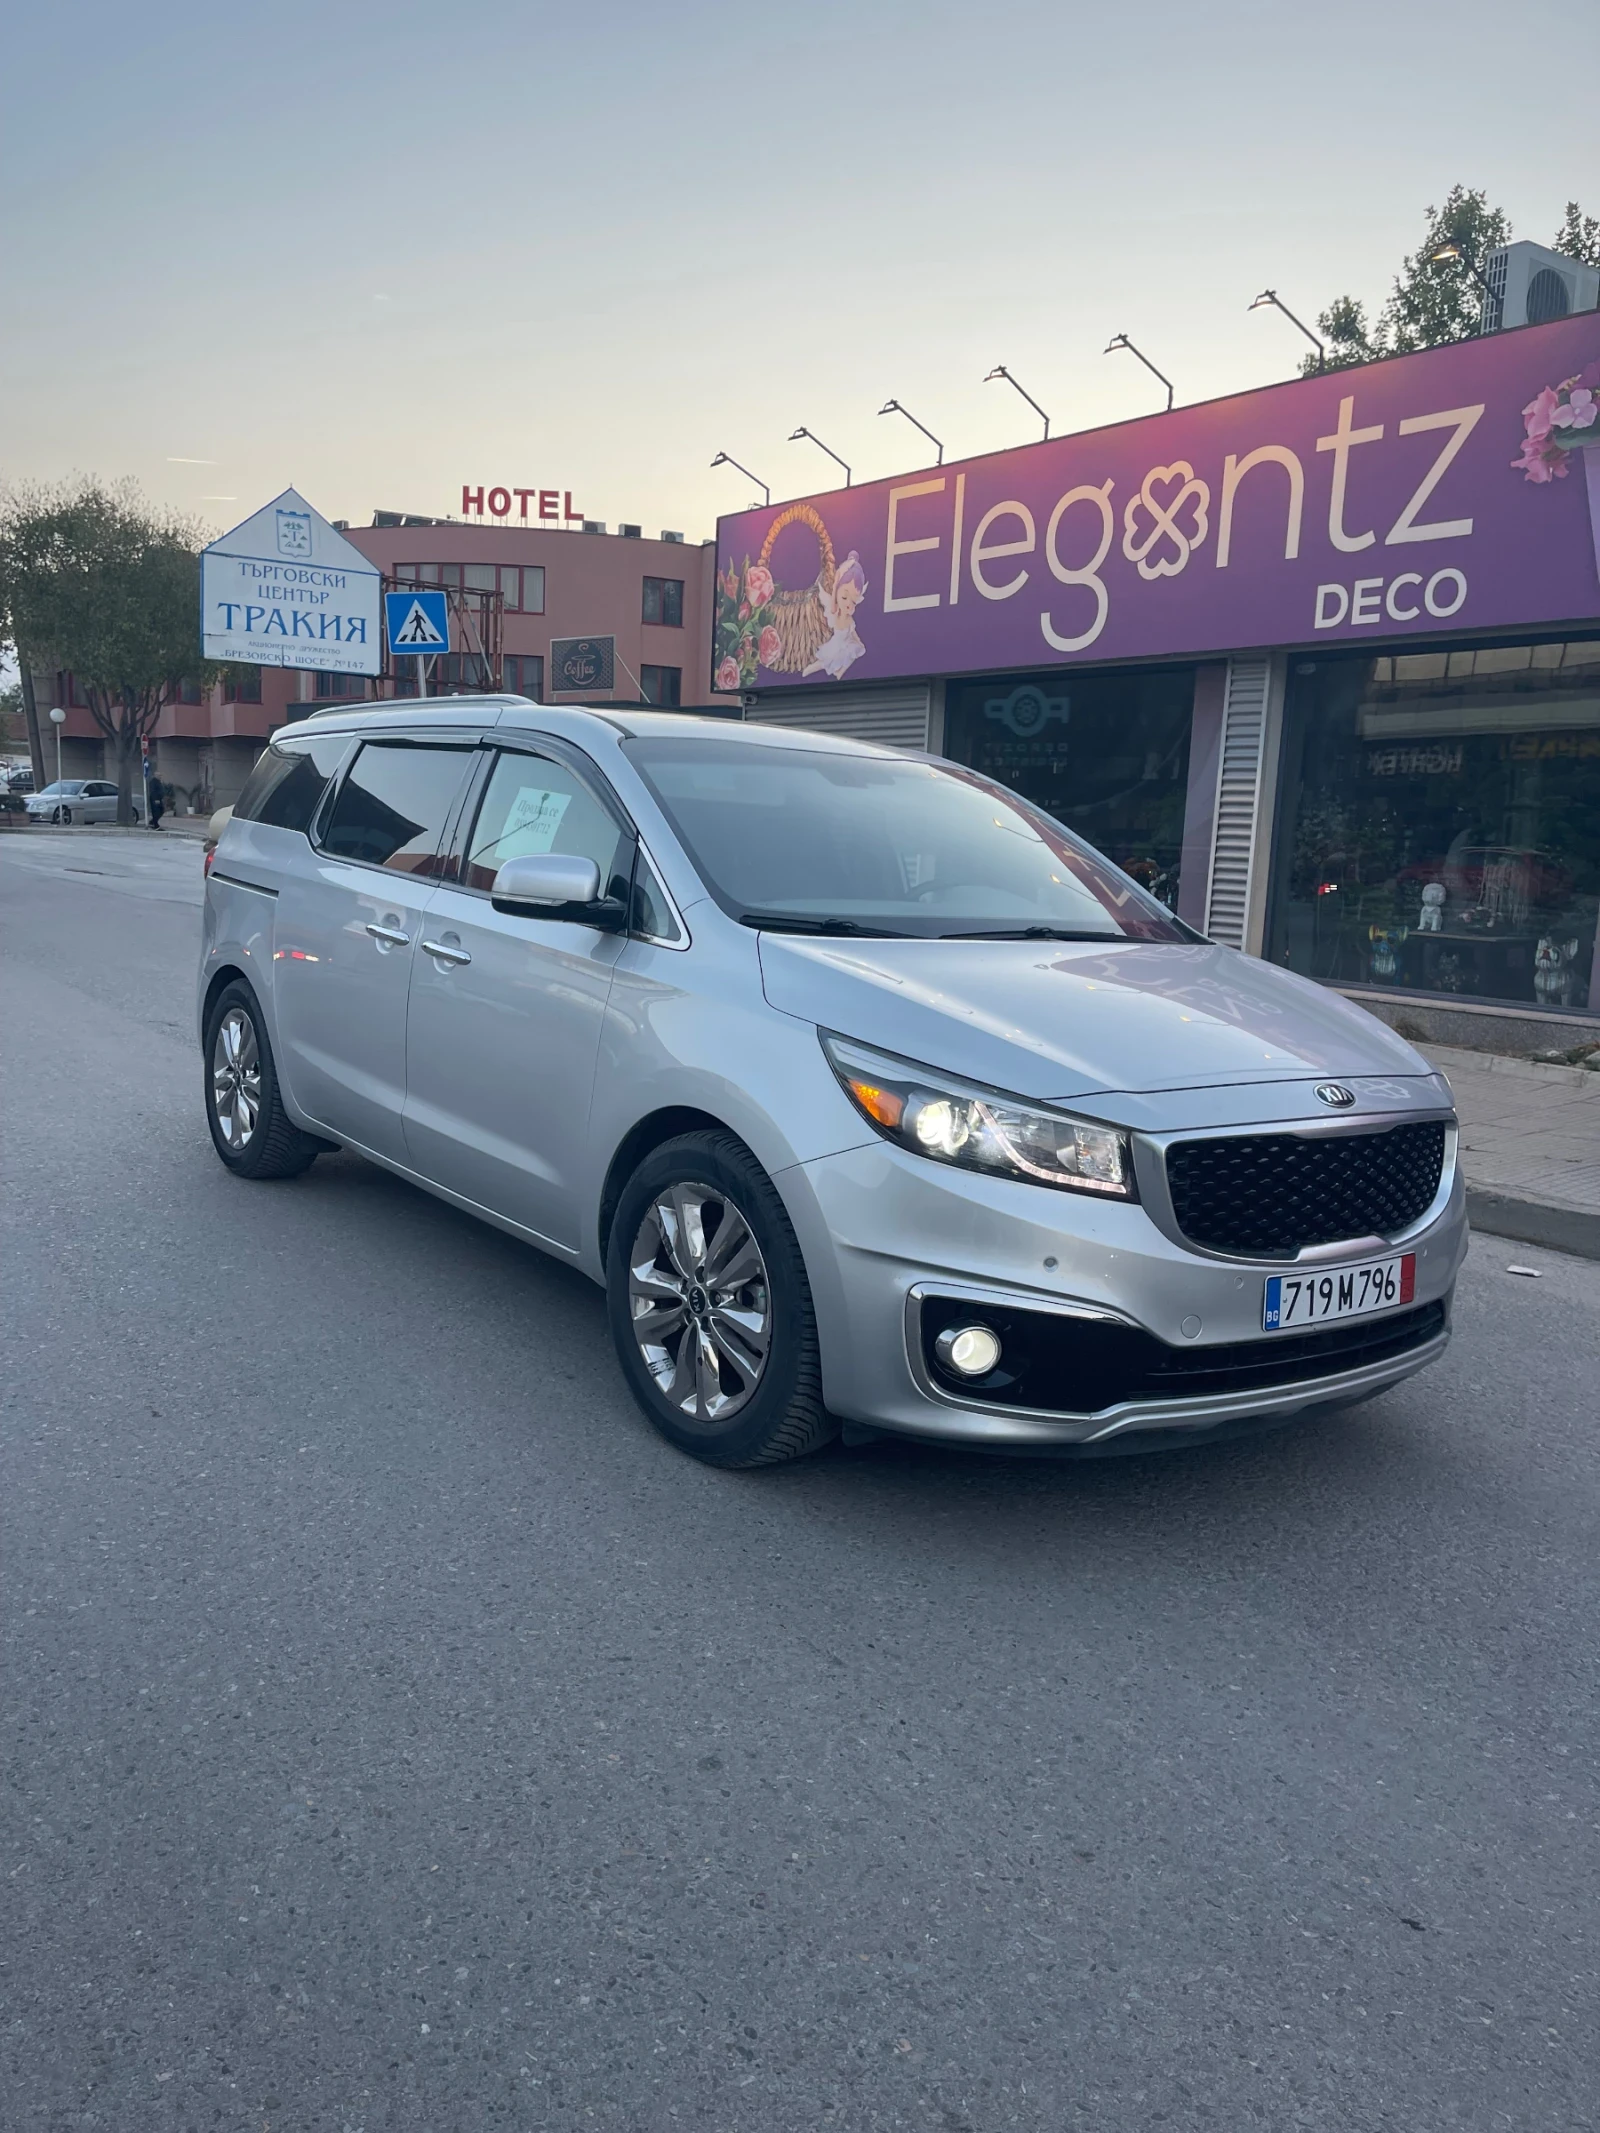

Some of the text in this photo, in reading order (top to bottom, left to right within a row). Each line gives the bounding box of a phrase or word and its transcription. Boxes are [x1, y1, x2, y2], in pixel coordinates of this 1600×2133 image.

[462, 485, 585, 520] HOTEL
[238, 562, 346, 589] ТЪРГОВСКИ
[258, 585, 330, 605] ЦЕНТЪР
[1314, 567, 1467, 630] DECO
[217, 602, 367, 644] ТРАКИЯ
[564, 658, 596, 681] Coffee
[1319, 1086, 1354, 1102] KIA
[692, 1290, 700, 1311] KIA
[1285, 1264, 1396, 1321] 719M796
[1266, 1310, 1279, 1323] BG
